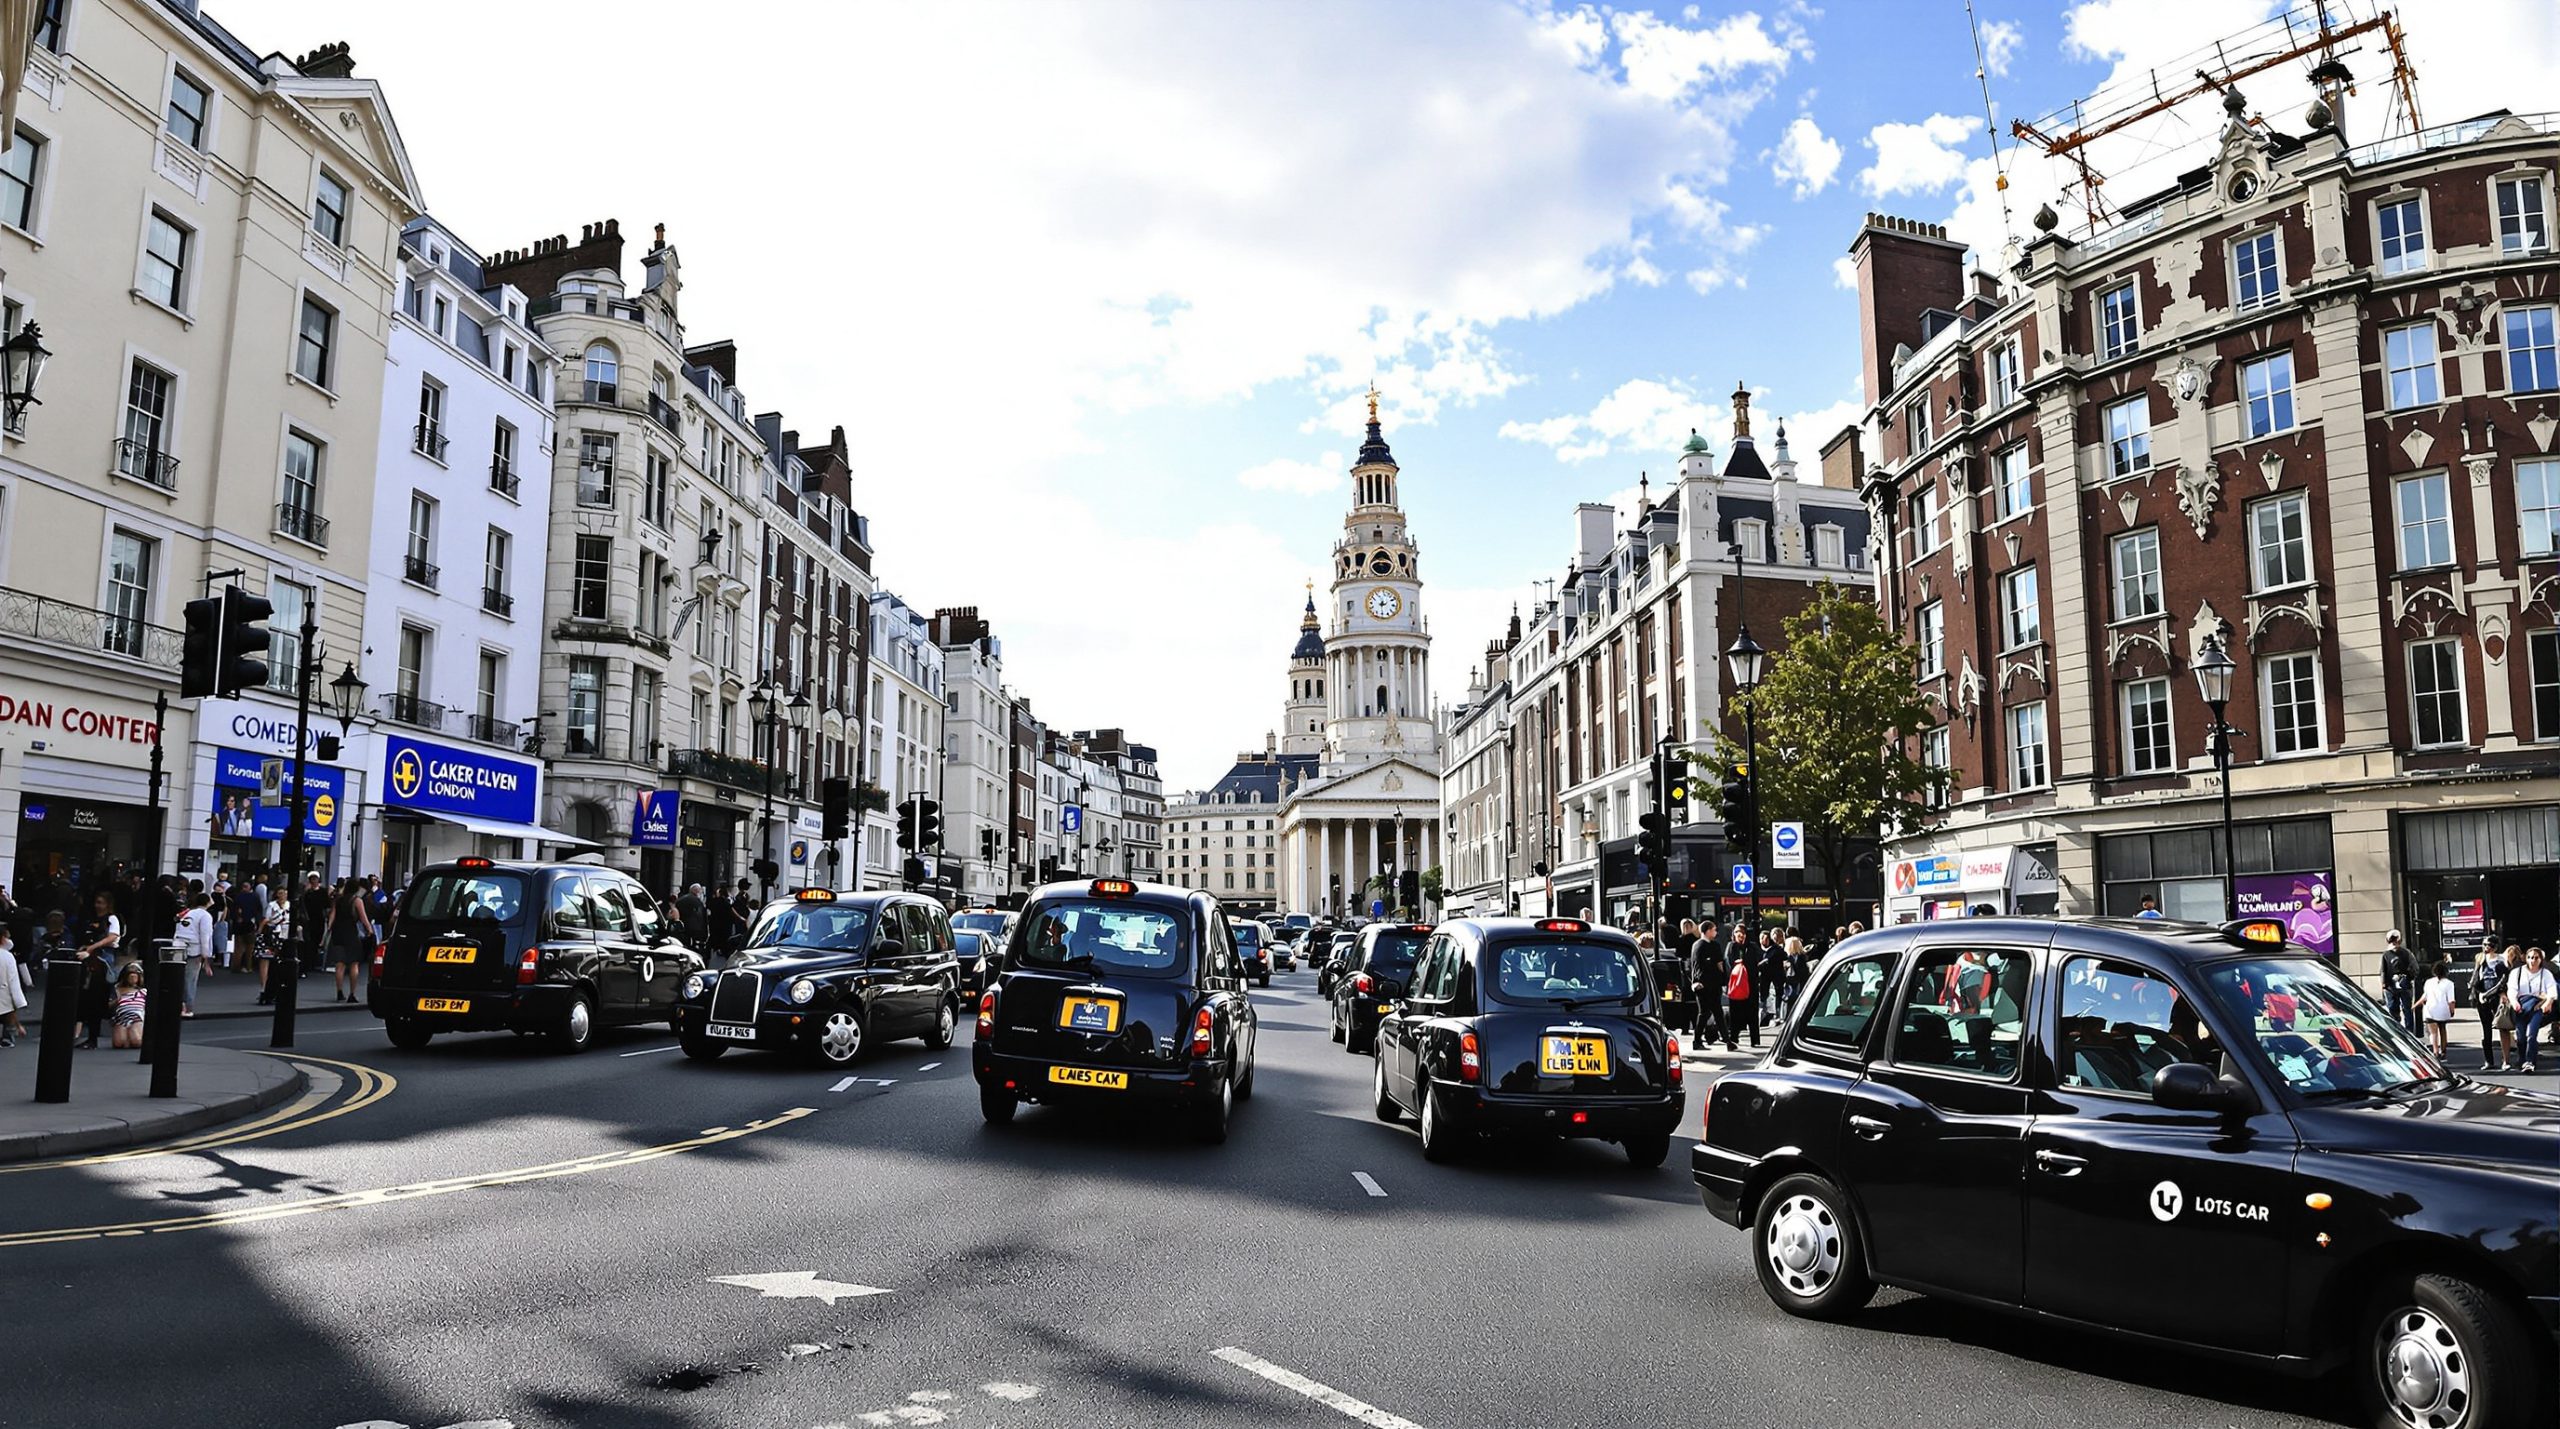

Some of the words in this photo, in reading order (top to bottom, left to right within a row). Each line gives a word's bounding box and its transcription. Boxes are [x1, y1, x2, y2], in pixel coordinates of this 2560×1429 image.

[429, 760, 474, 784] CAKER
[428, 780, 476, 801] LONDON
[2195, 1196, 2232, 1216] LOTS
[2235, 1202, 2270, 1222] CAR
